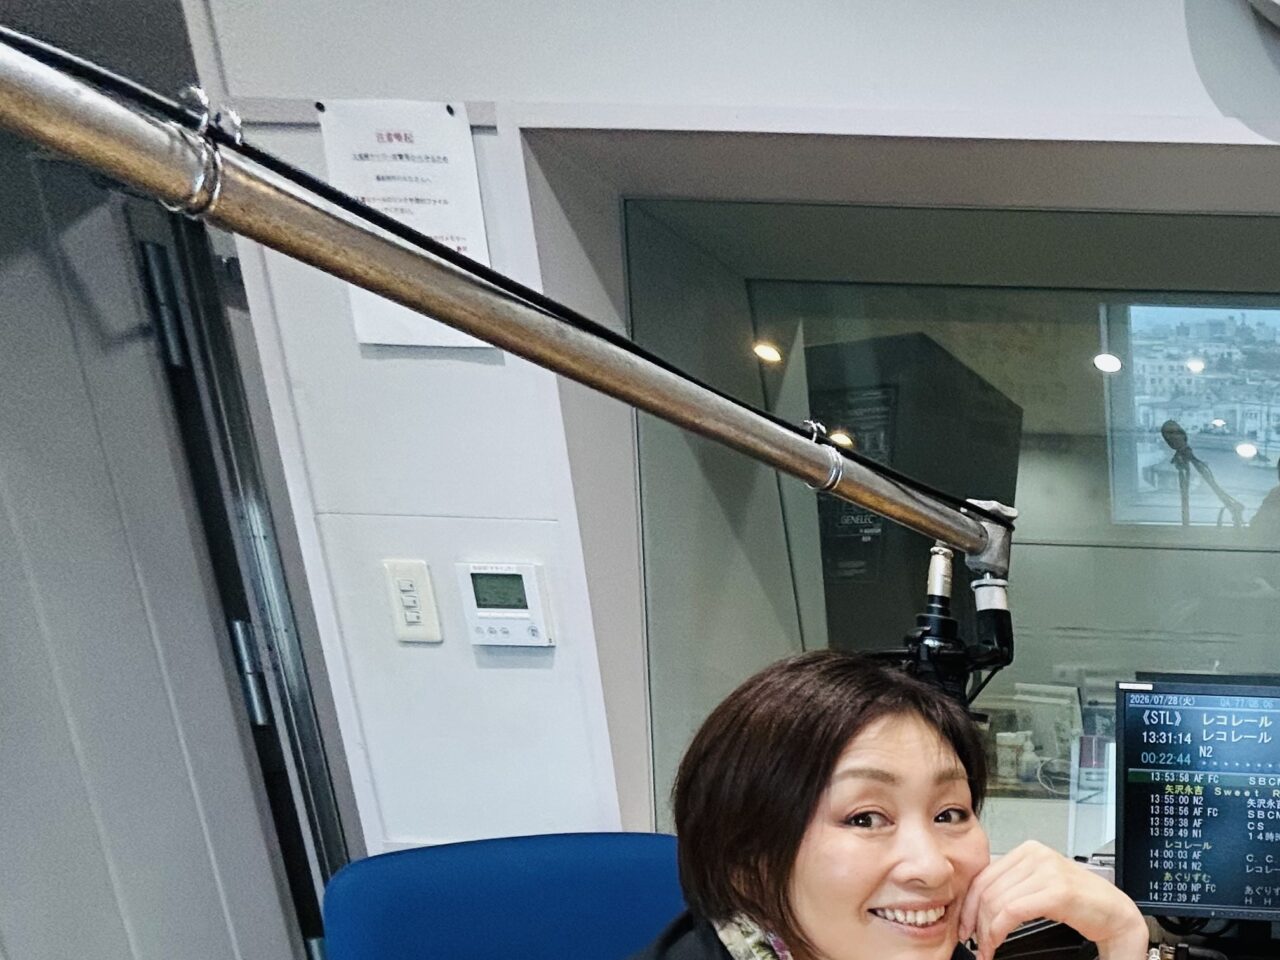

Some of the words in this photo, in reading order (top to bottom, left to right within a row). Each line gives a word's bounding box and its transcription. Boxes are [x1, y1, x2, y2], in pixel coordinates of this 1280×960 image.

[840, 515, 874, 525] GENELEC
[1203, 713, 1273, 728] レコレール
[1142, 731, 1192, 744] 13:31:14
[1202, 729, 1272, 743] レコレール
[1199, 746, 1213, 758] N2
[1141, 752, 1191, 765] 00:22:44
[1151, 772, 1189, 782] 13:53:58
[1194, 774, 1204, 783] AF
[1208, 774, 1220, 783] FC
[1165, 784, 1204, 796] 矢沢永吉
[1214, 787, 1259, 797] Sweet
[1150, 794, 1189, 804] 13:55:00
[1193, 796, 1204, 805] N2
[1150, 805, 1189, 815] 13:58:56
[1193, 807, 1203, 816] AF
[1207, 807, 1218, 817] FC
[1150, 817, 1189, 827] 13:59:38
[1192, 819, 1203, 828] AF
[1247, 822, 1265, 831] CS
[1150, 827, 1188, 837] 13:59:49
[1192, 829, 1202, 838] N1
[1165, 840, 1212, 850] レコレール
[1150, 849, 1188, 859] 14:00:03
[1192, 850, 1202, 860] AF
[1149, 860, 1188, 870] 14:00:14
[1191, 862, 1202, 871] N2
[1149, 881, 1187, 891] 14:20:00
[1206, 883, 1216, 893] FC
[1149, 892, 1187, 902] 14:27:39
[1191, 894, 1201, 902] AF
